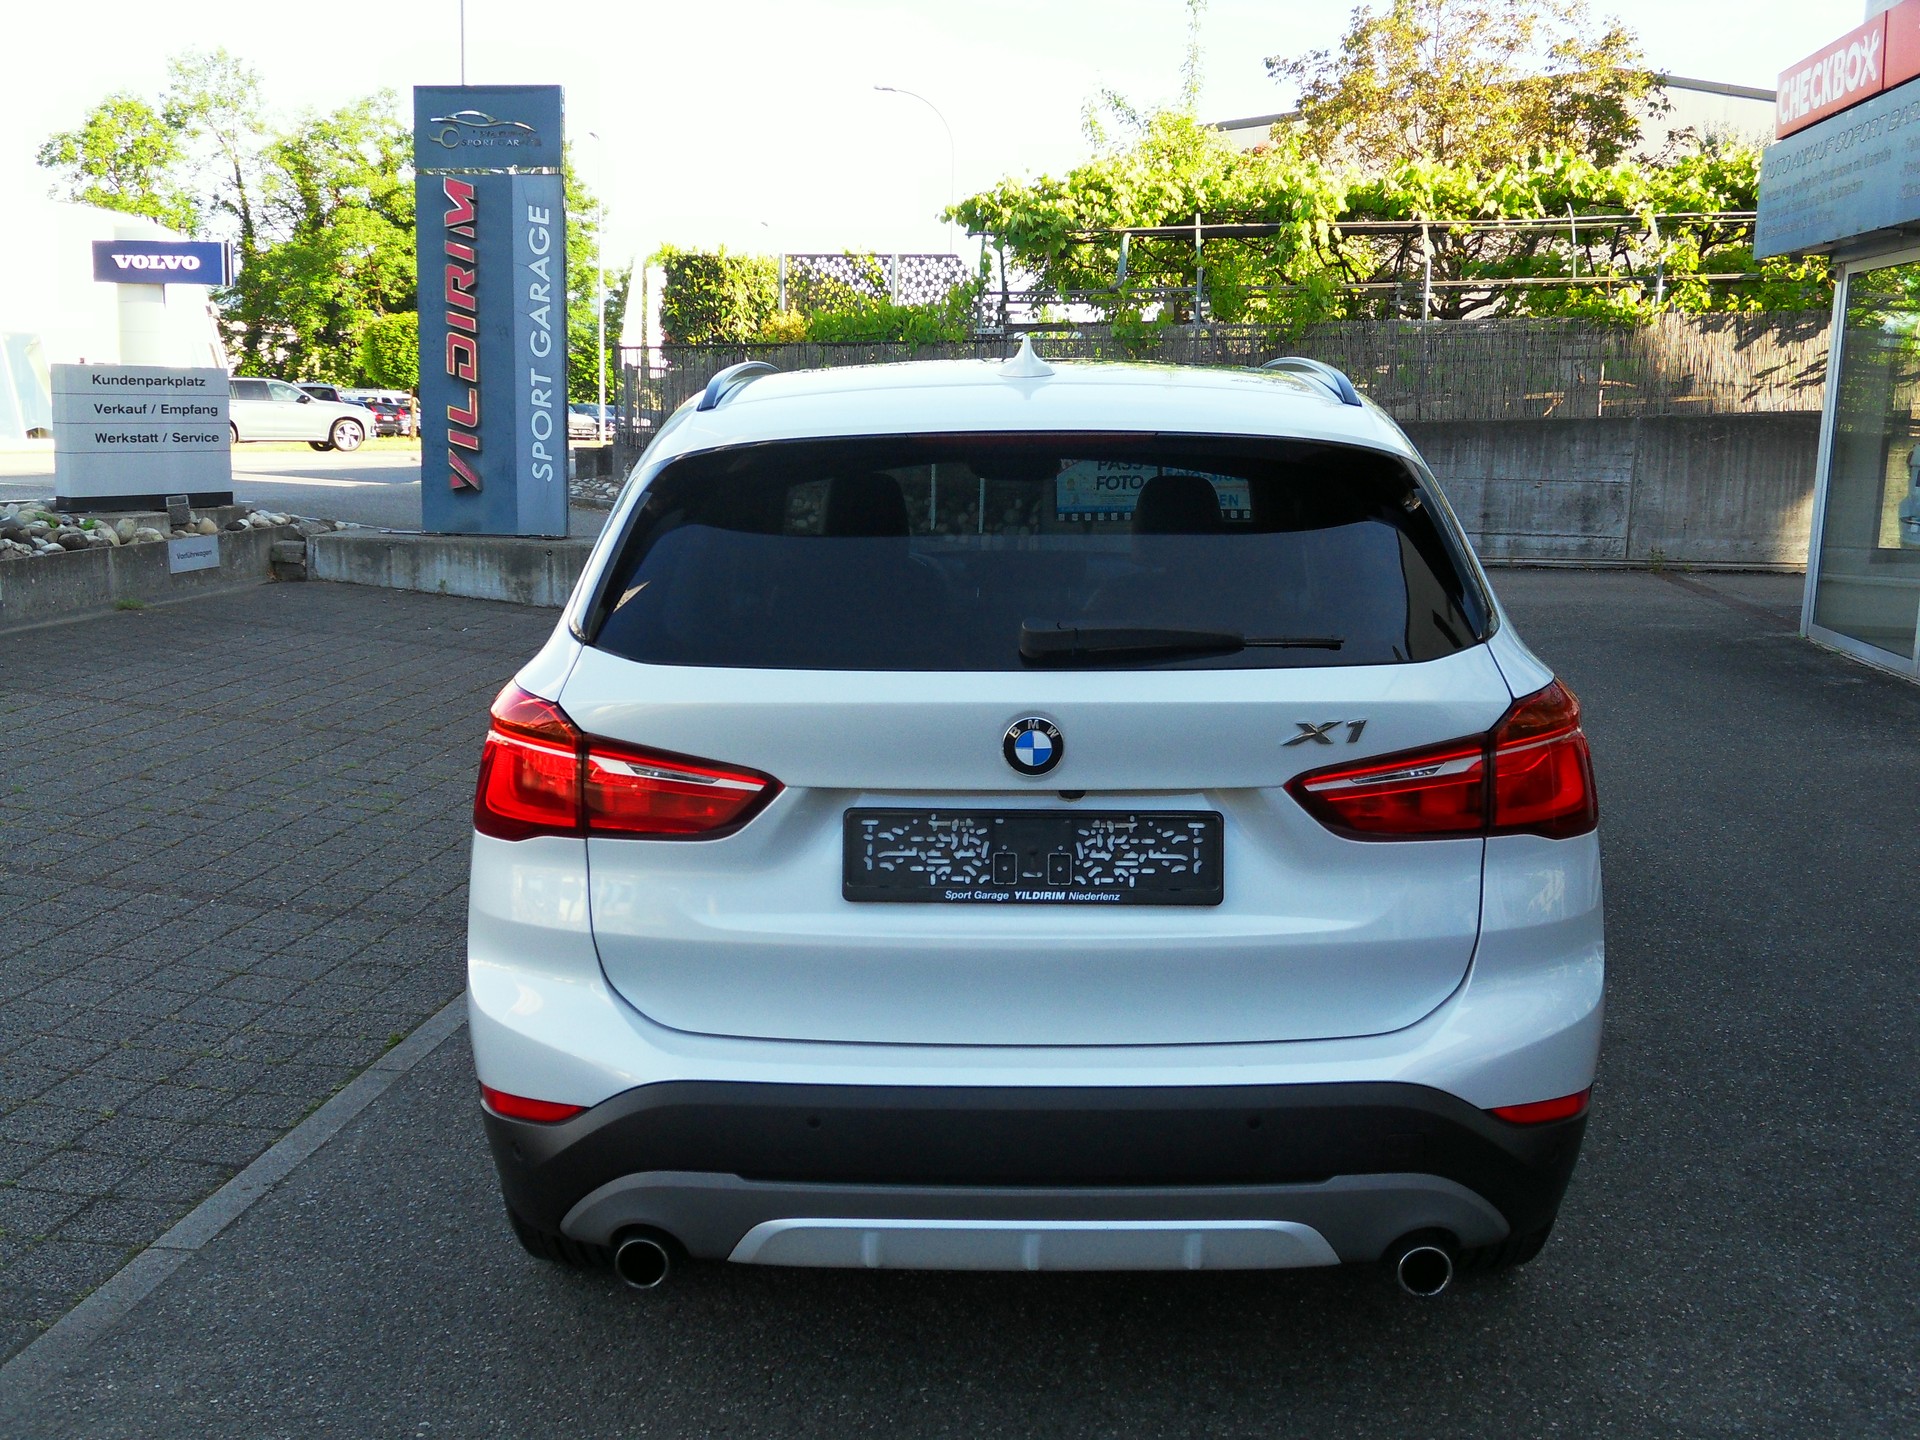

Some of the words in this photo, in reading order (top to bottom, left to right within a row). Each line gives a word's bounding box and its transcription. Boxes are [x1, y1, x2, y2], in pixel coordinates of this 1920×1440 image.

[1778, 29, 1880, 126] CHECKBOX
[1835, 113, 1888, 154] SOFORT
[111, 254, 201, 271] VOLVO
[528, 205, 552, 358] GARAGE
[92, 374, 206, 388] Kundenparkplatz
[94, 403, 147, 415] Verkauf
[161, 404, 218, 417] Empfang
[530, 367, 553, 482] SPORT
[95, 433, 159, 444] Werkstatt
[172, 432, 220, 443] Service
[1096, 474, 1144, 491] FOTO
[1008, 719, 1060, 739] BMW
[1280, 718, 1368, 747] X1
[945, 891, 971, 901] Sport
[974, 891, 1009, 902] Garage
[1014, 891, 1066, 901] YILDIRIM
[1068, 891, 1121, 901] Niederlenz
